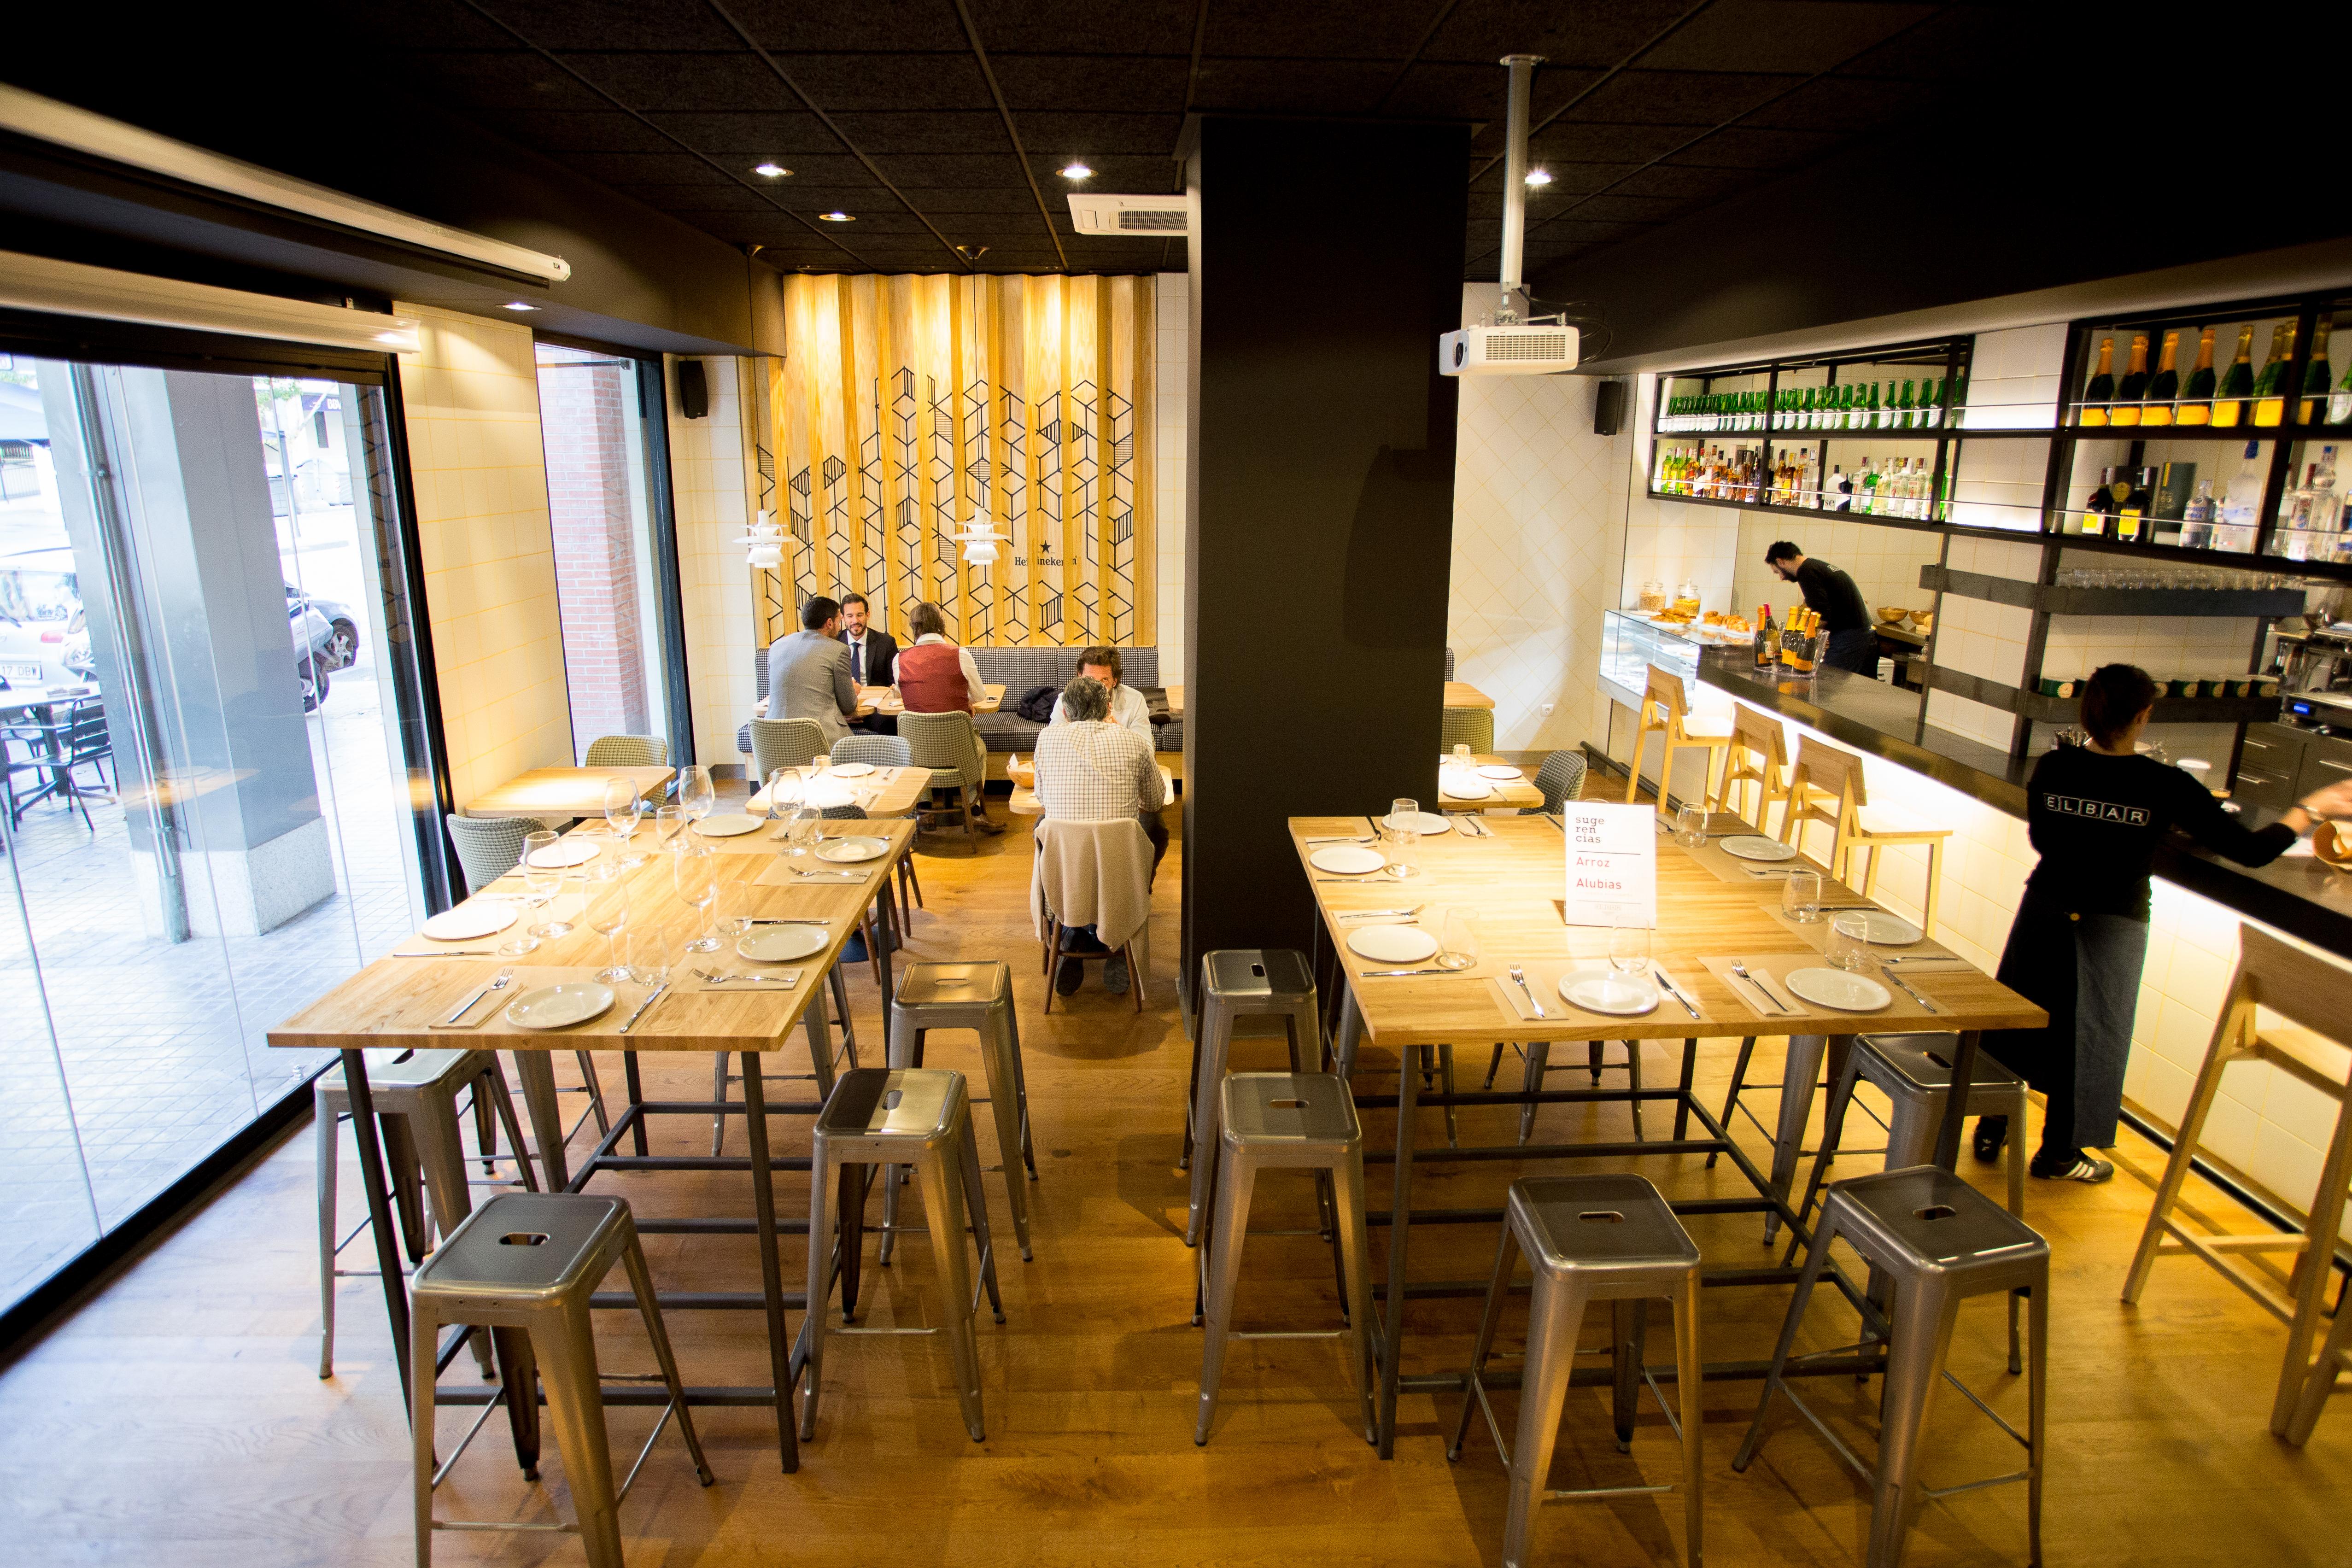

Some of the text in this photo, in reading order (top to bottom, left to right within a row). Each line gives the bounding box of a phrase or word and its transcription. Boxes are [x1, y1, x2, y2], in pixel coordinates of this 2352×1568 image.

[327, 398, 341, 410] BBV
[1575, 816, 1604, 826] suge
[1575, 834, 1601, 843] cias
[1576, 856, 1610, 867] Arroz
[1576, 878, 1622, 889] Alubias
